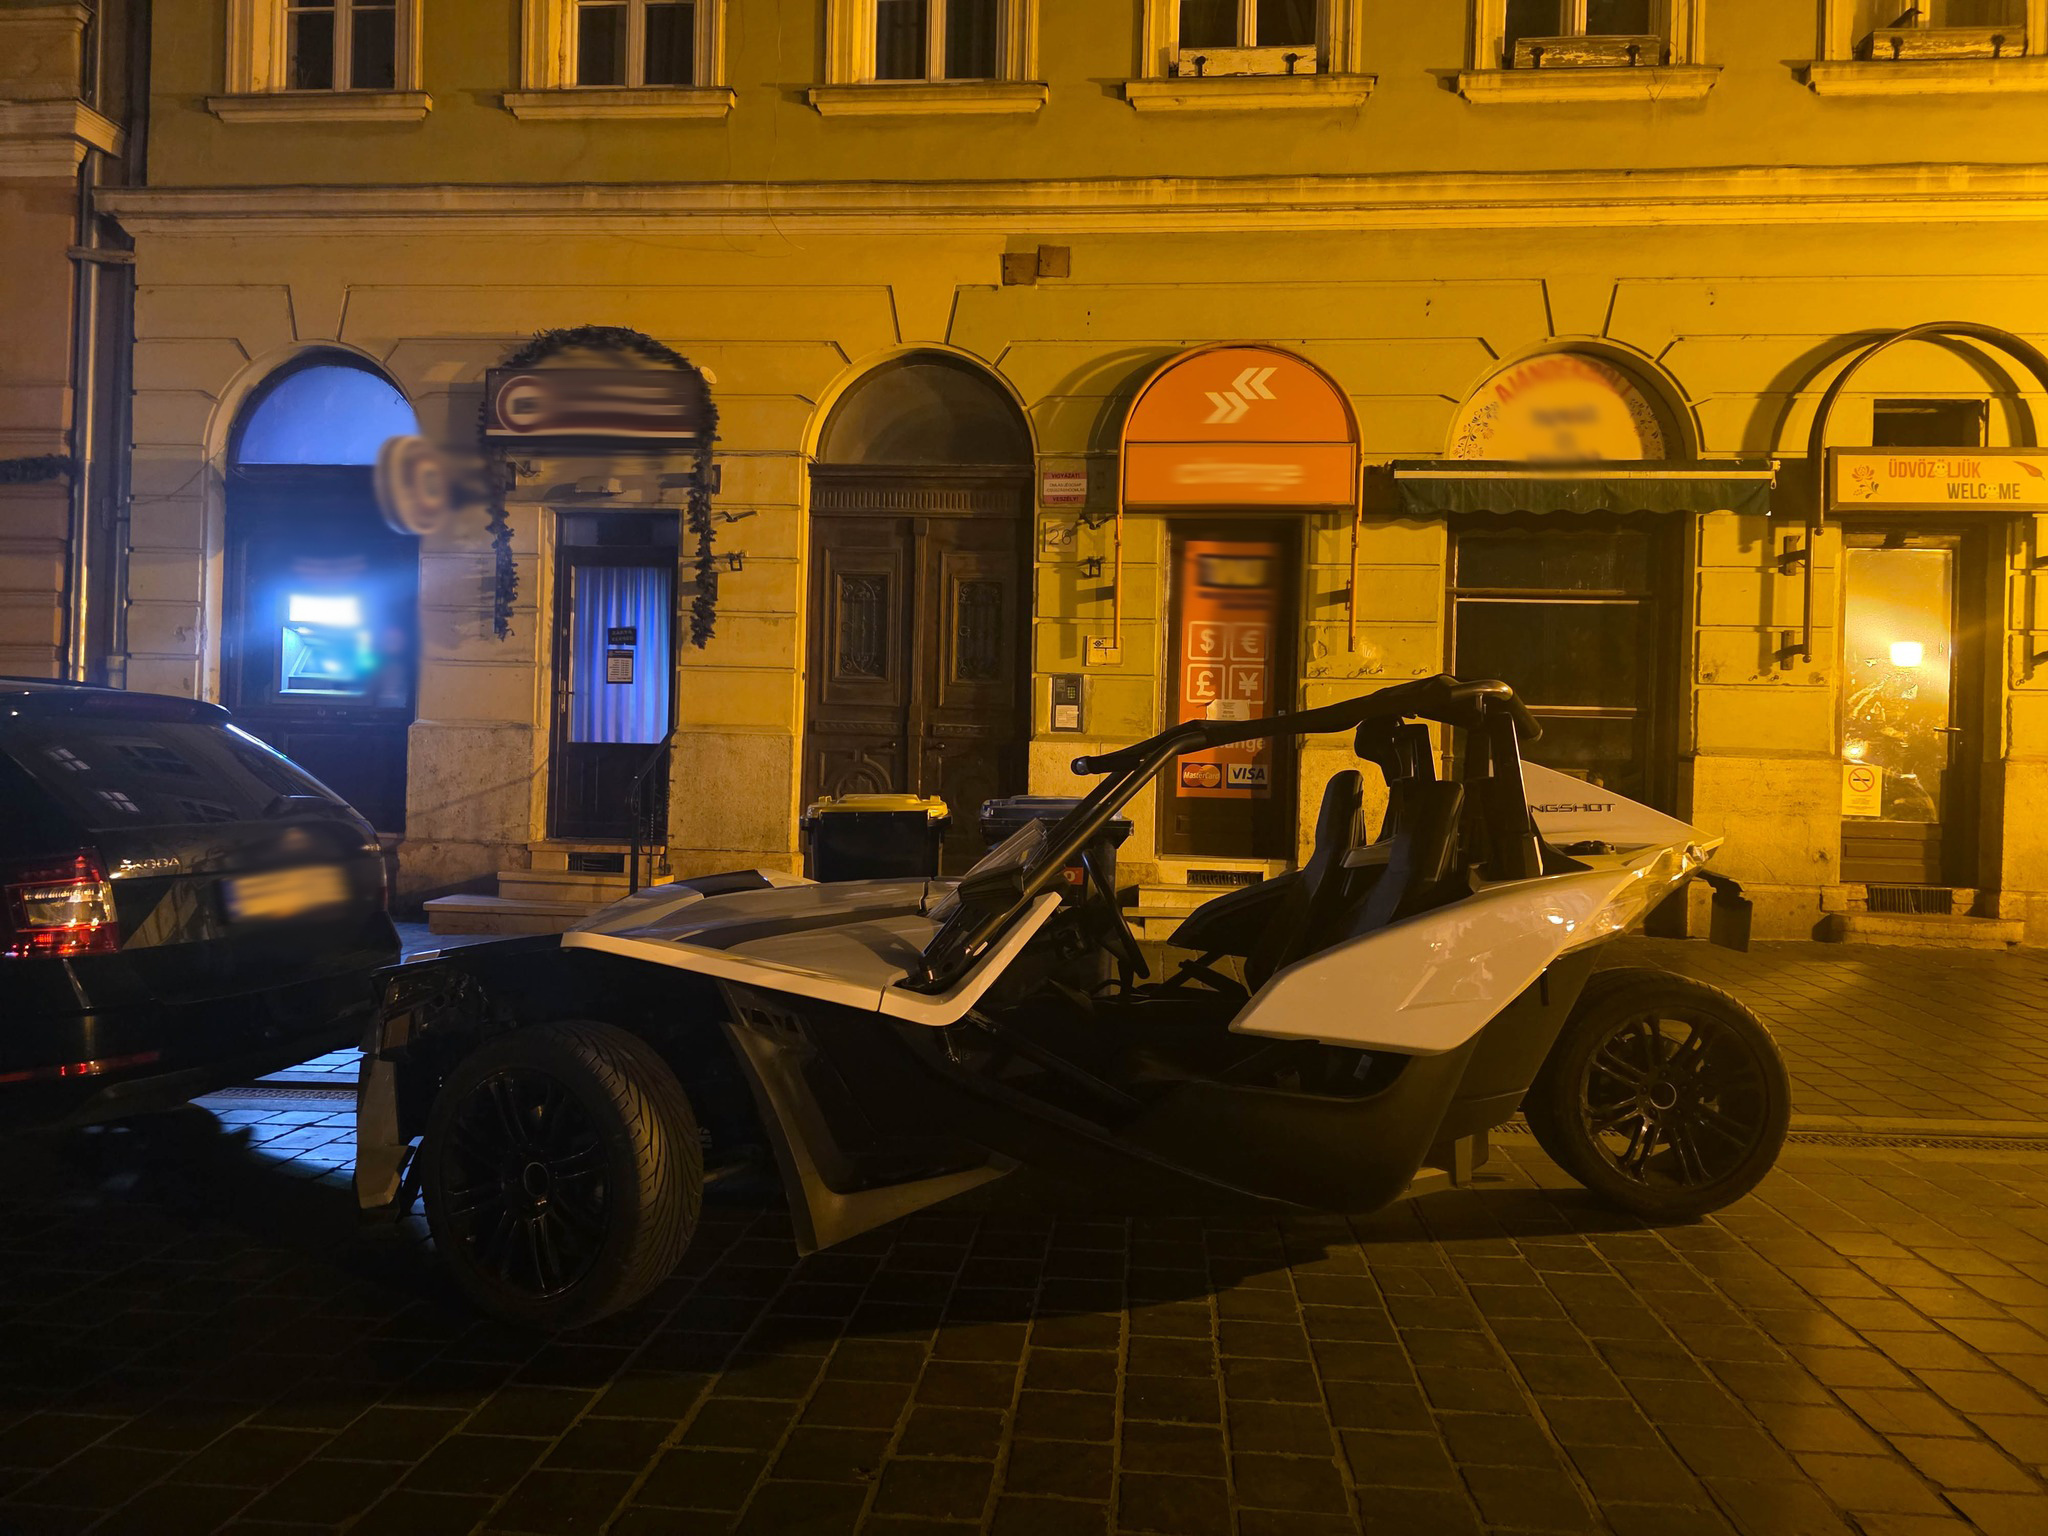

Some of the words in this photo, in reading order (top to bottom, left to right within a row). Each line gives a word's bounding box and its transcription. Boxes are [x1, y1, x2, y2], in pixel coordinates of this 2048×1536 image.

[1200, 628, 1215, 654] $
[1241, 630, 1259, 654] €
[1196, 670, 1215, 696] £
[1239, 672, 1259, 696] ¥
[1183, 771, 1220, 780] MasterCard
[1232, 768, 1265, 780] VISA
[1529, 803, 1616, 813] NGSHOT
